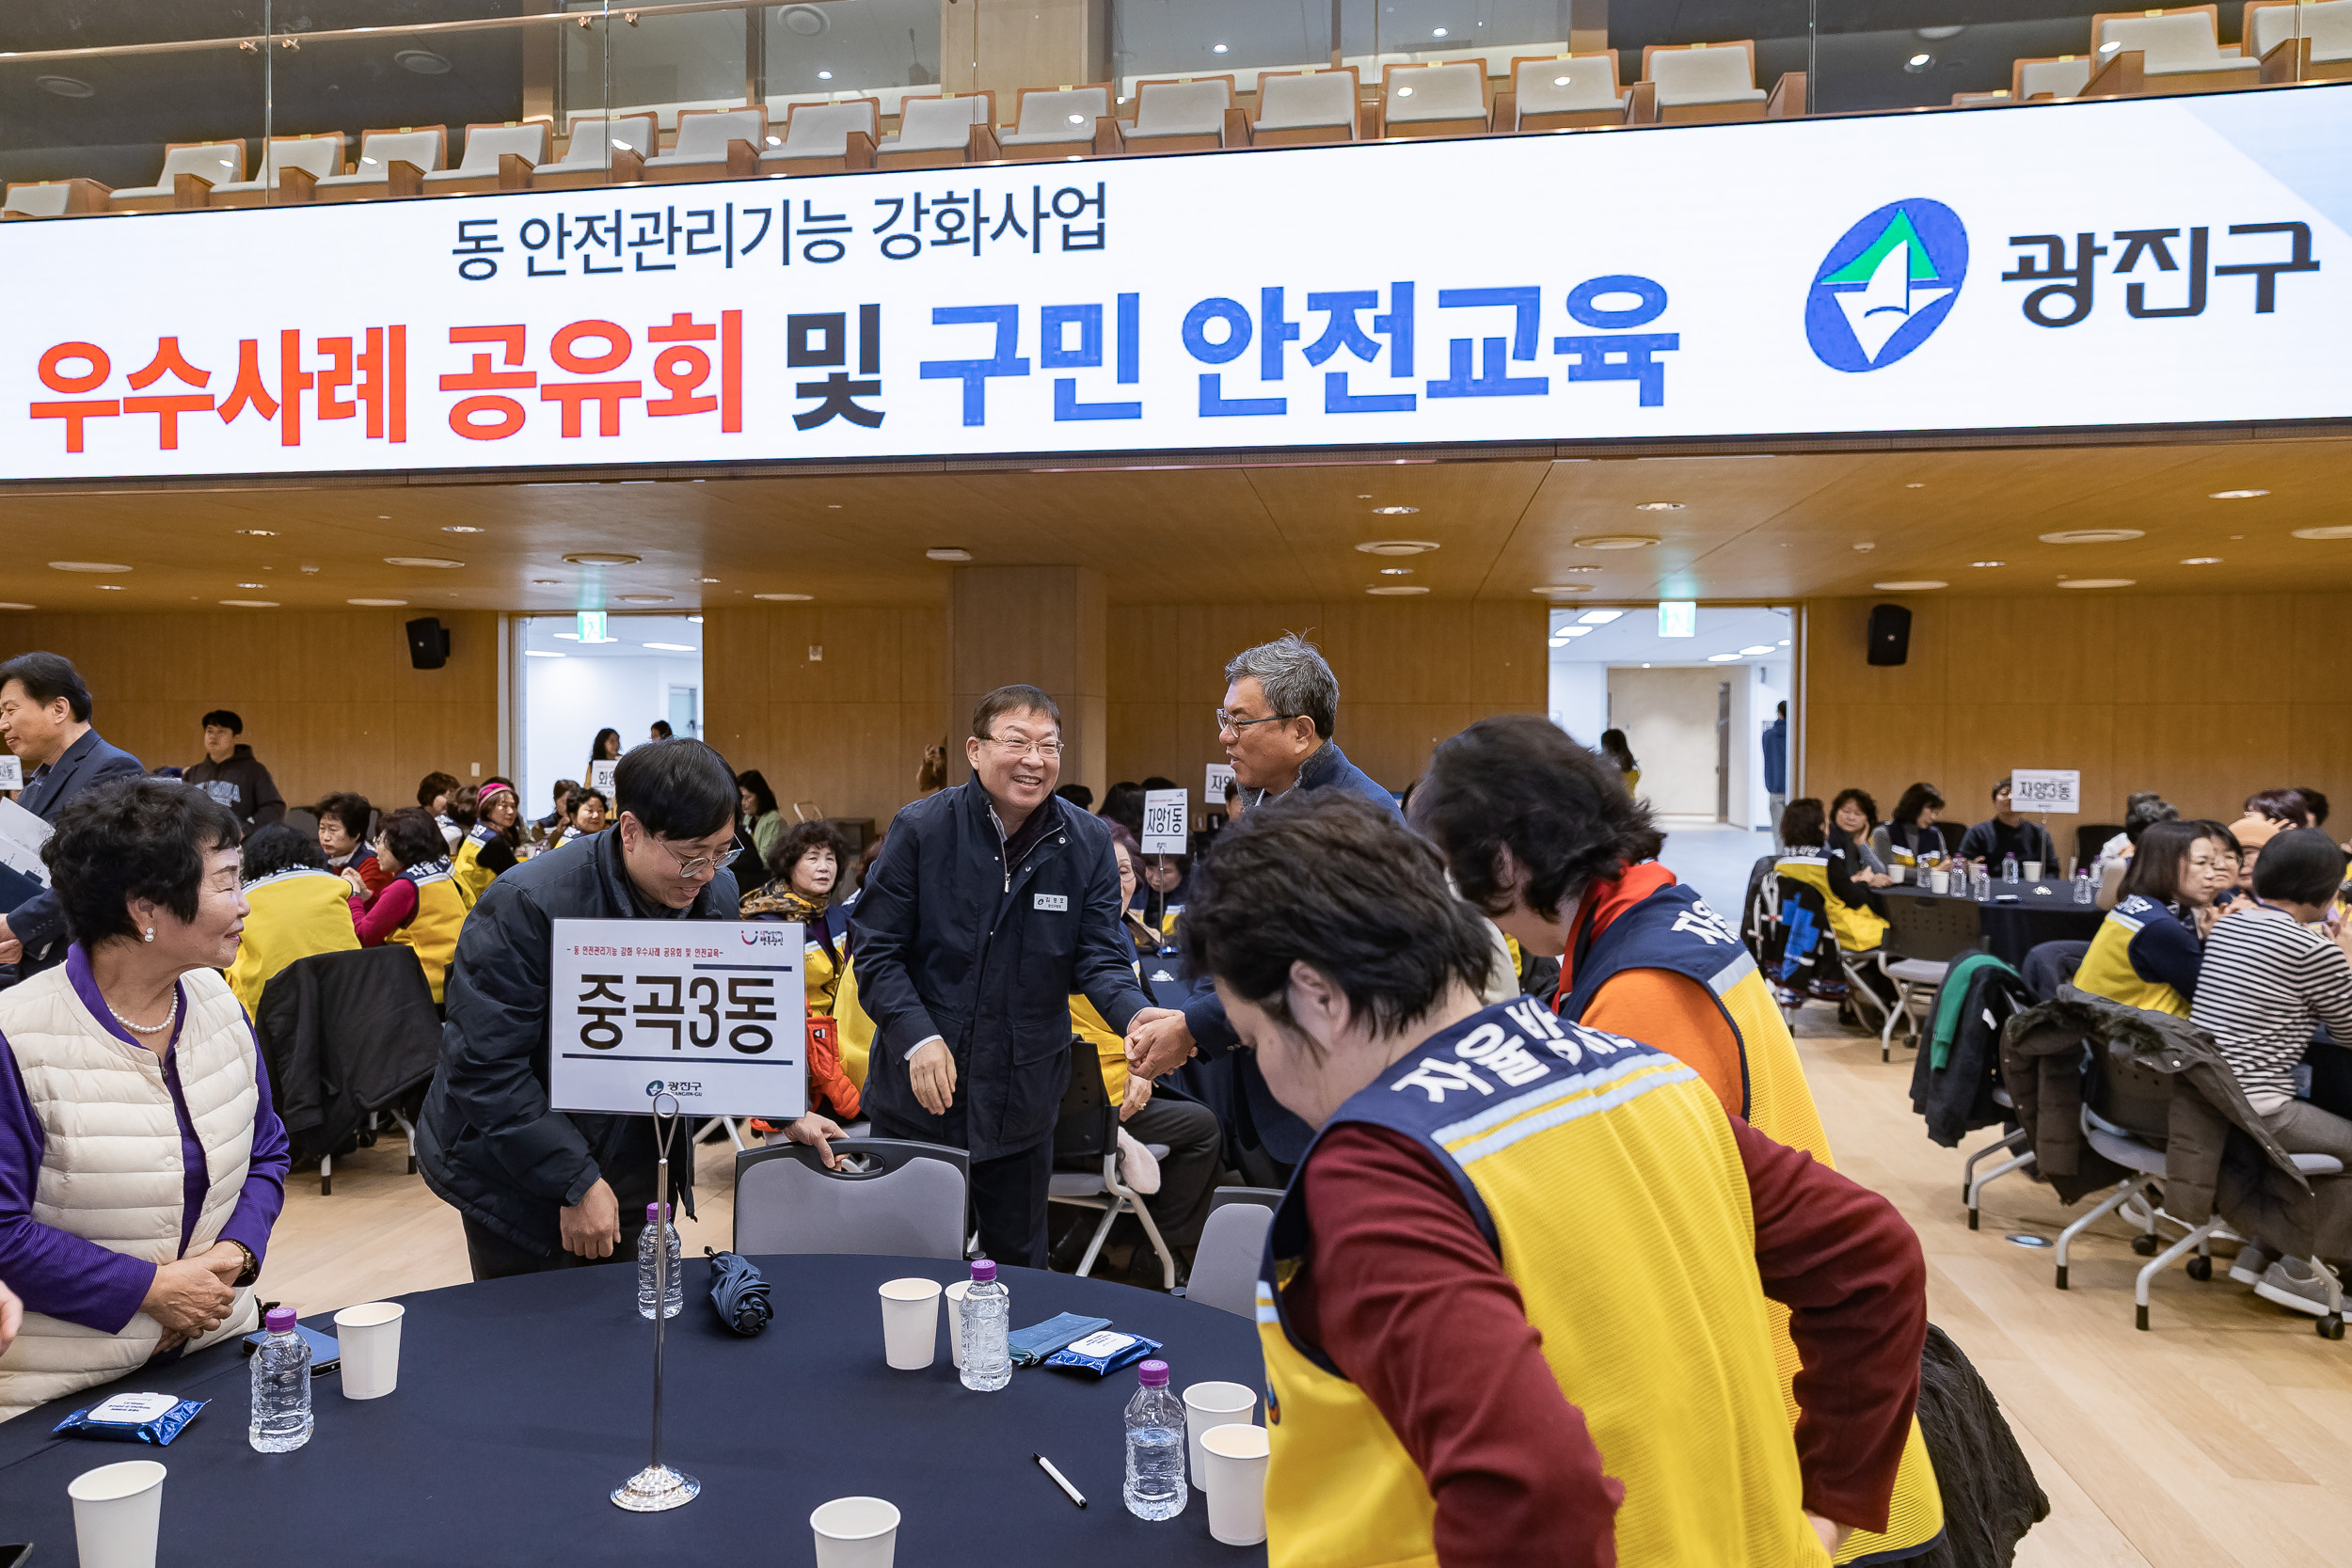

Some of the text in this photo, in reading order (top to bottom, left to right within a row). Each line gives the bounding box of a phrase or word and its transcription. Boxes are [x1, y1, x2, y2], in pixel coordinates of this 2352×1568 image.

[453, 181, 1106, 281] 동 안전관리기능 강화사업
[2002, 220, 2321, 329] 광진구
[29, 274, 1680, 454] 우수사례 공유회 및 구민 안전교육
[1147, 808, 1183, 833] 자양1동
[573, 945, 580, 956] 동
[636, 946, 660, 958] 우수사례
[663, 947, 682, 958] 공유회
[577, 974, 778, 1055] 중곡3동
[667, 1081, 703, 1091] 광진구
